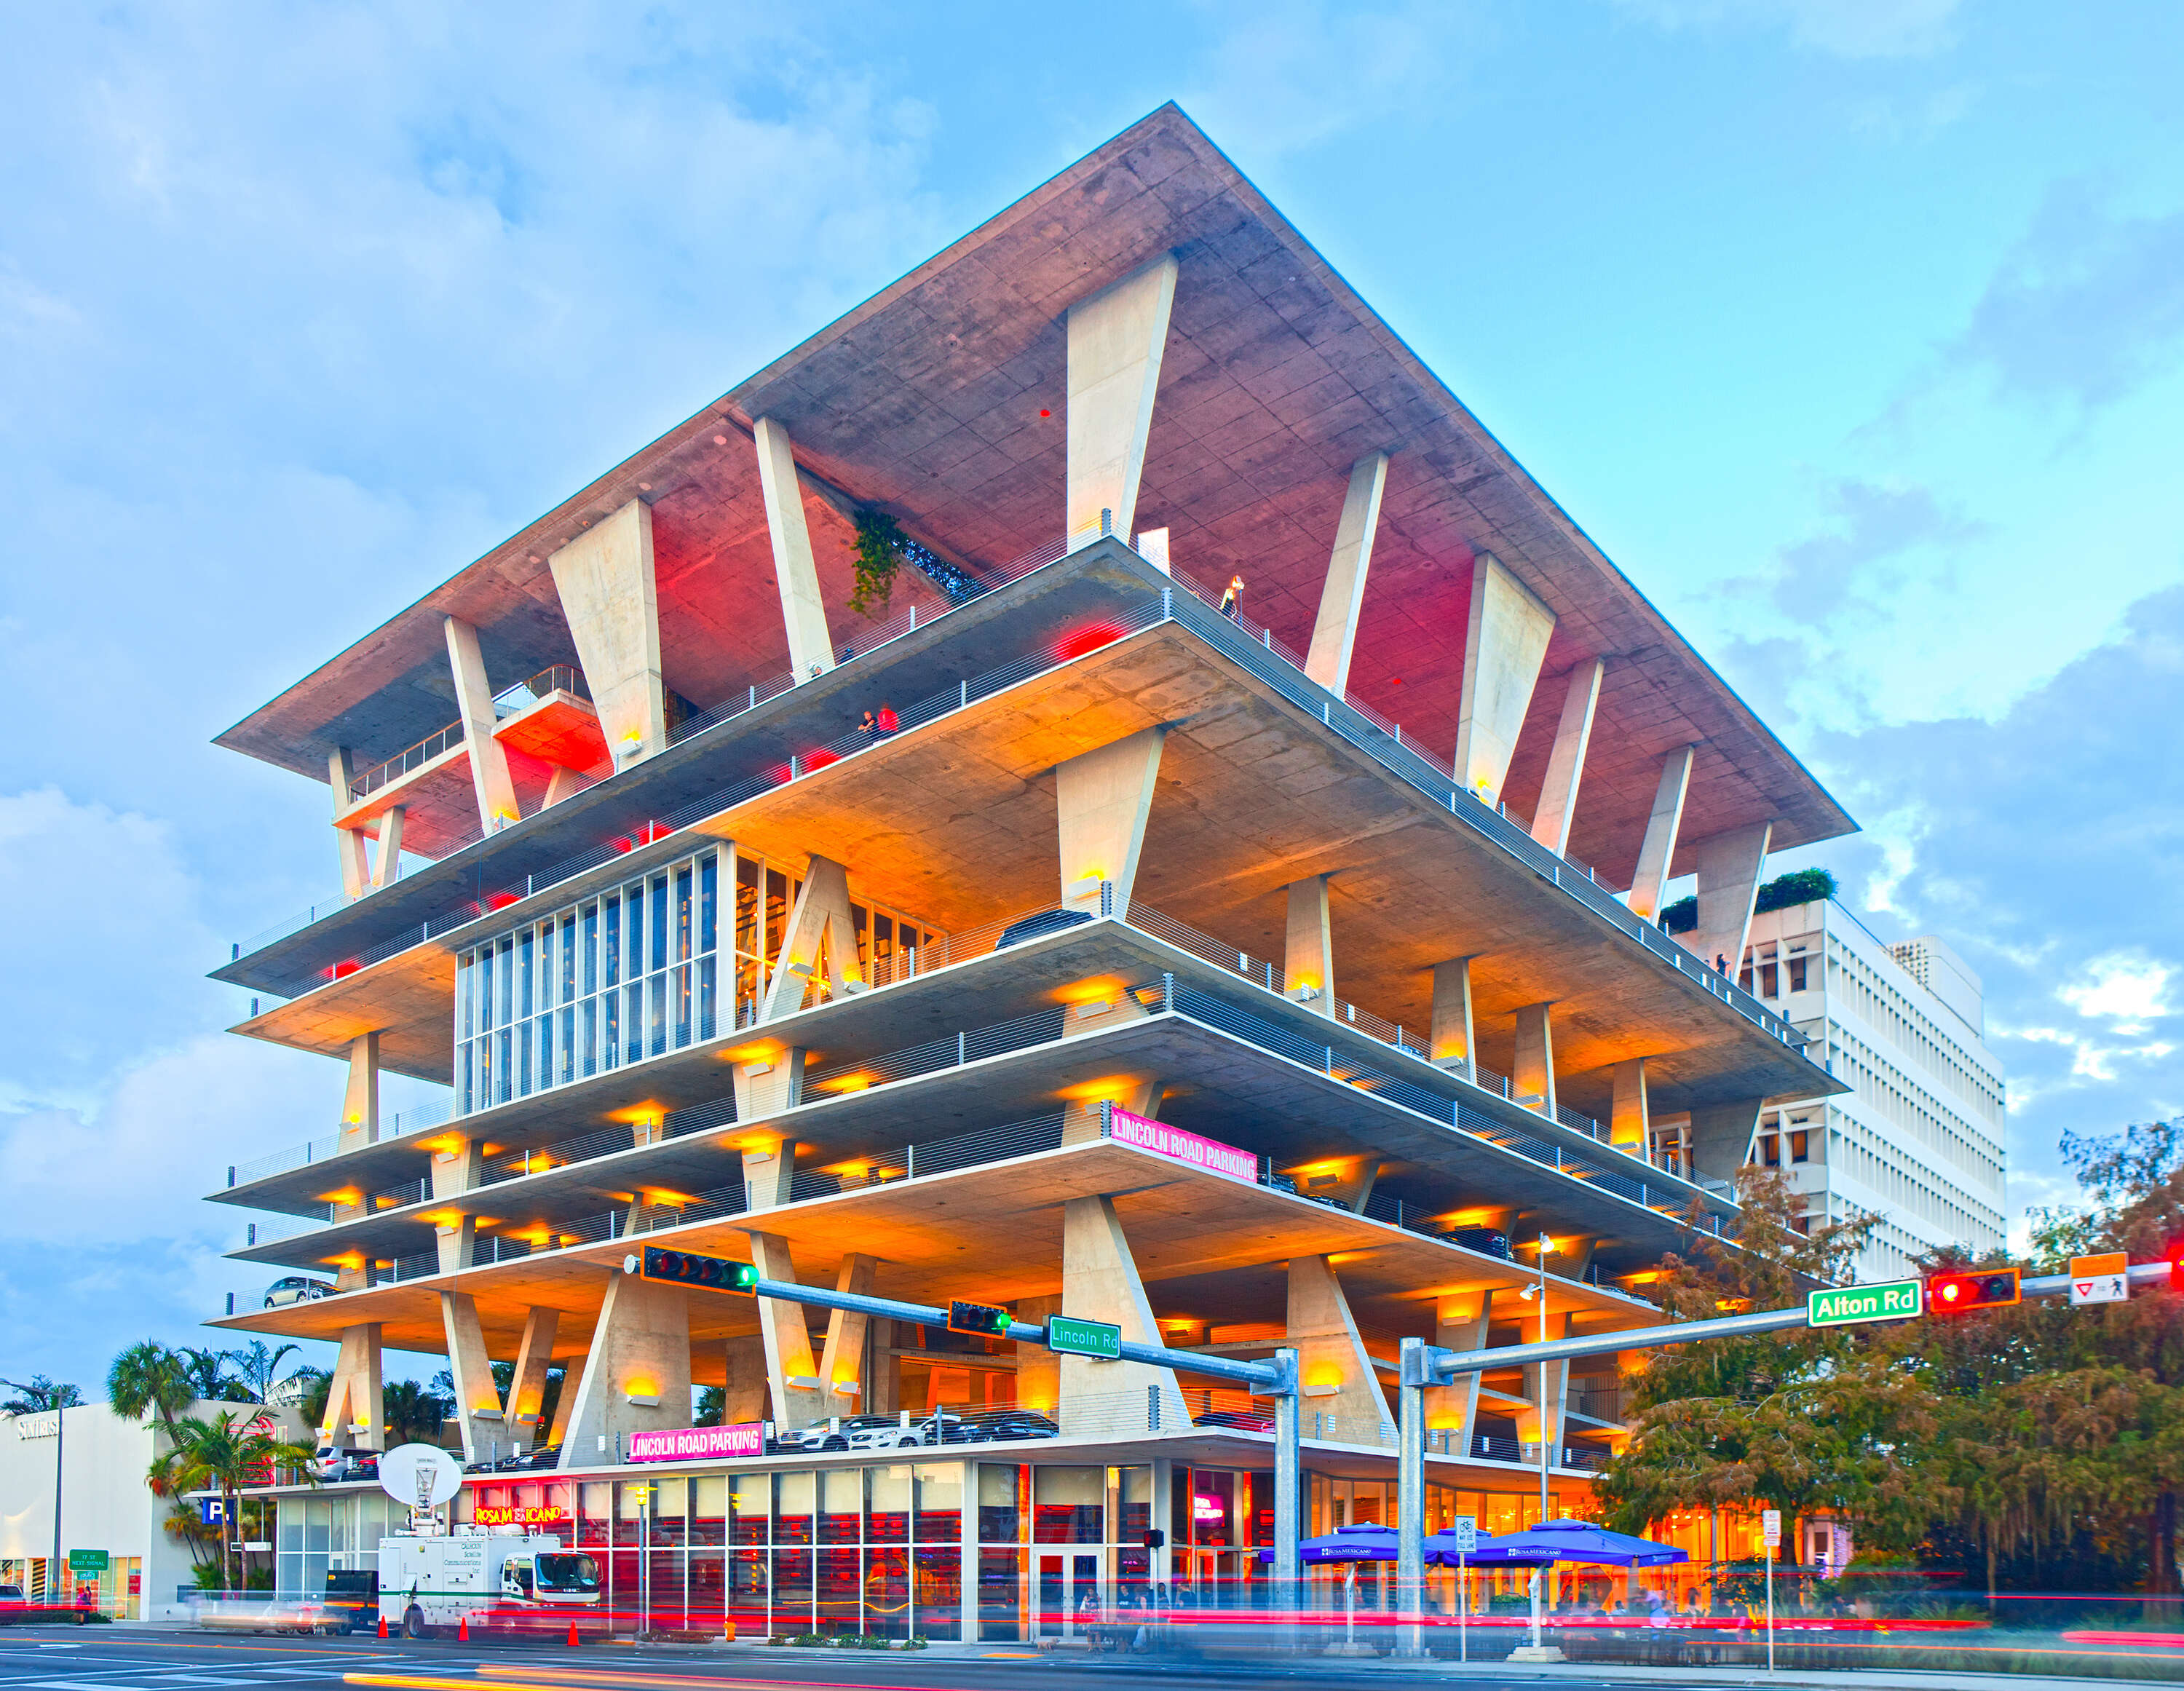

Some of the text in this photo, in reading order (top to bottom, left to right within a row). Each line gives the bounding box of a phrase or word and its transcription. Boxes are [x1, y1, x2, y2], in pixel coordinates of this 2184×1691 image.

[1114, 1114, 1255, 1180] LINCOLN ROAD PARKING
[1816, 1288, 1914, 1318] Alton Rd
[1052, 1325, 1117, 1349] Lincoln Rd
[630, 1430, 759, 1457] LINCOLN ROAD PARKING
